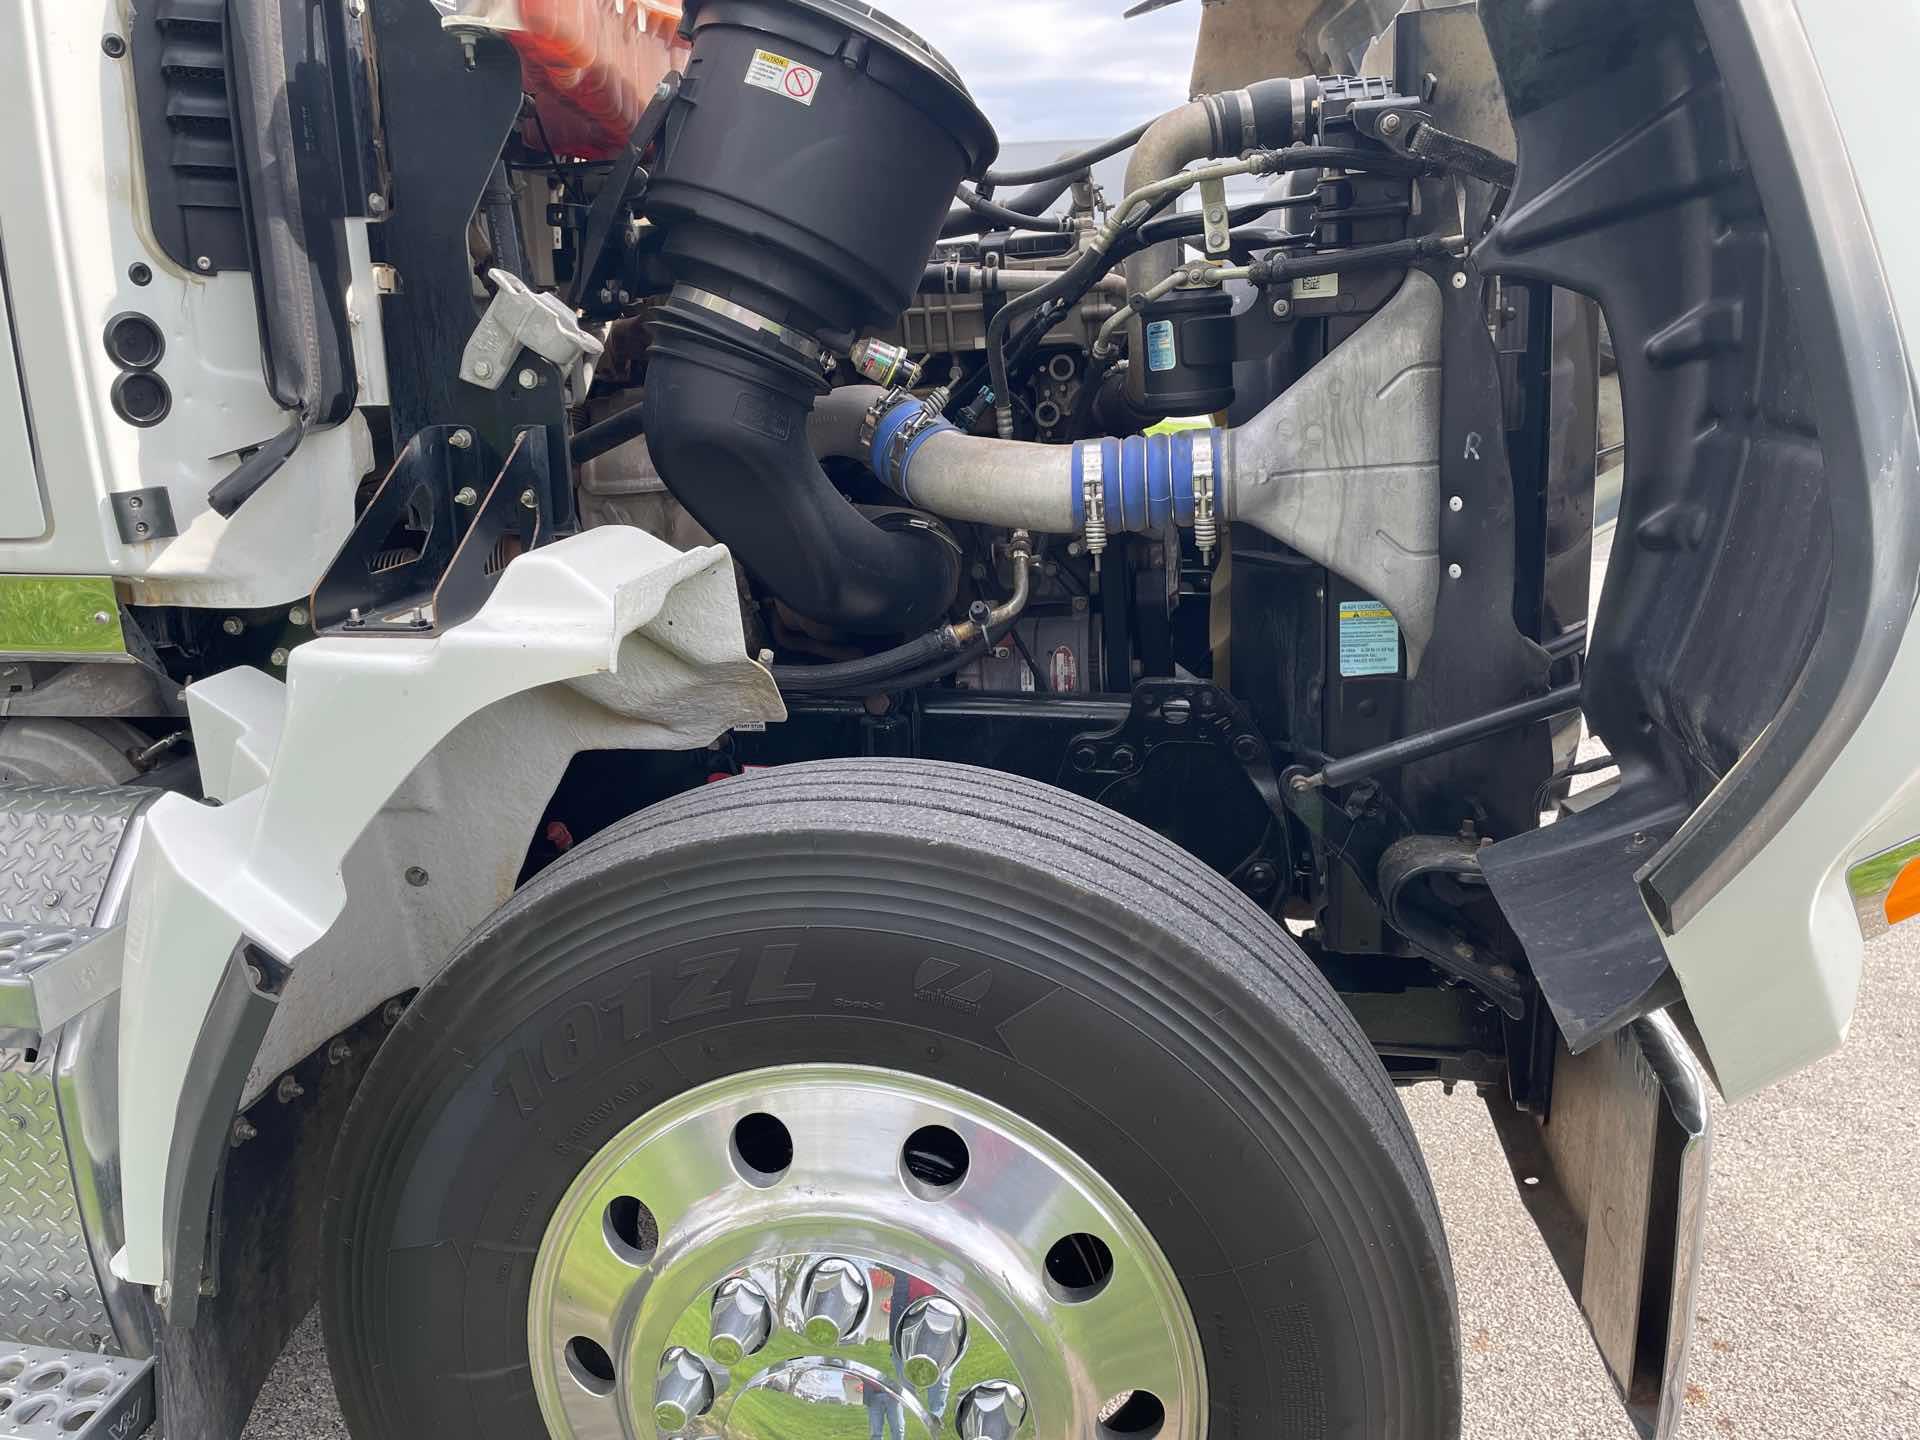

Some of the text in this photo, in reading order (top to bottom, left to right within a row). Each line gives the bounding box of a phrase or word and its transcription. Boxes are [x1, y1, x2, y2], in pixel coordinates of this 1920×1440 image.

[759, 52, 785, 65] CAUTION
[1464, 432, 1481, 459] R
[490, 943, 817, 1118] 101ZL
